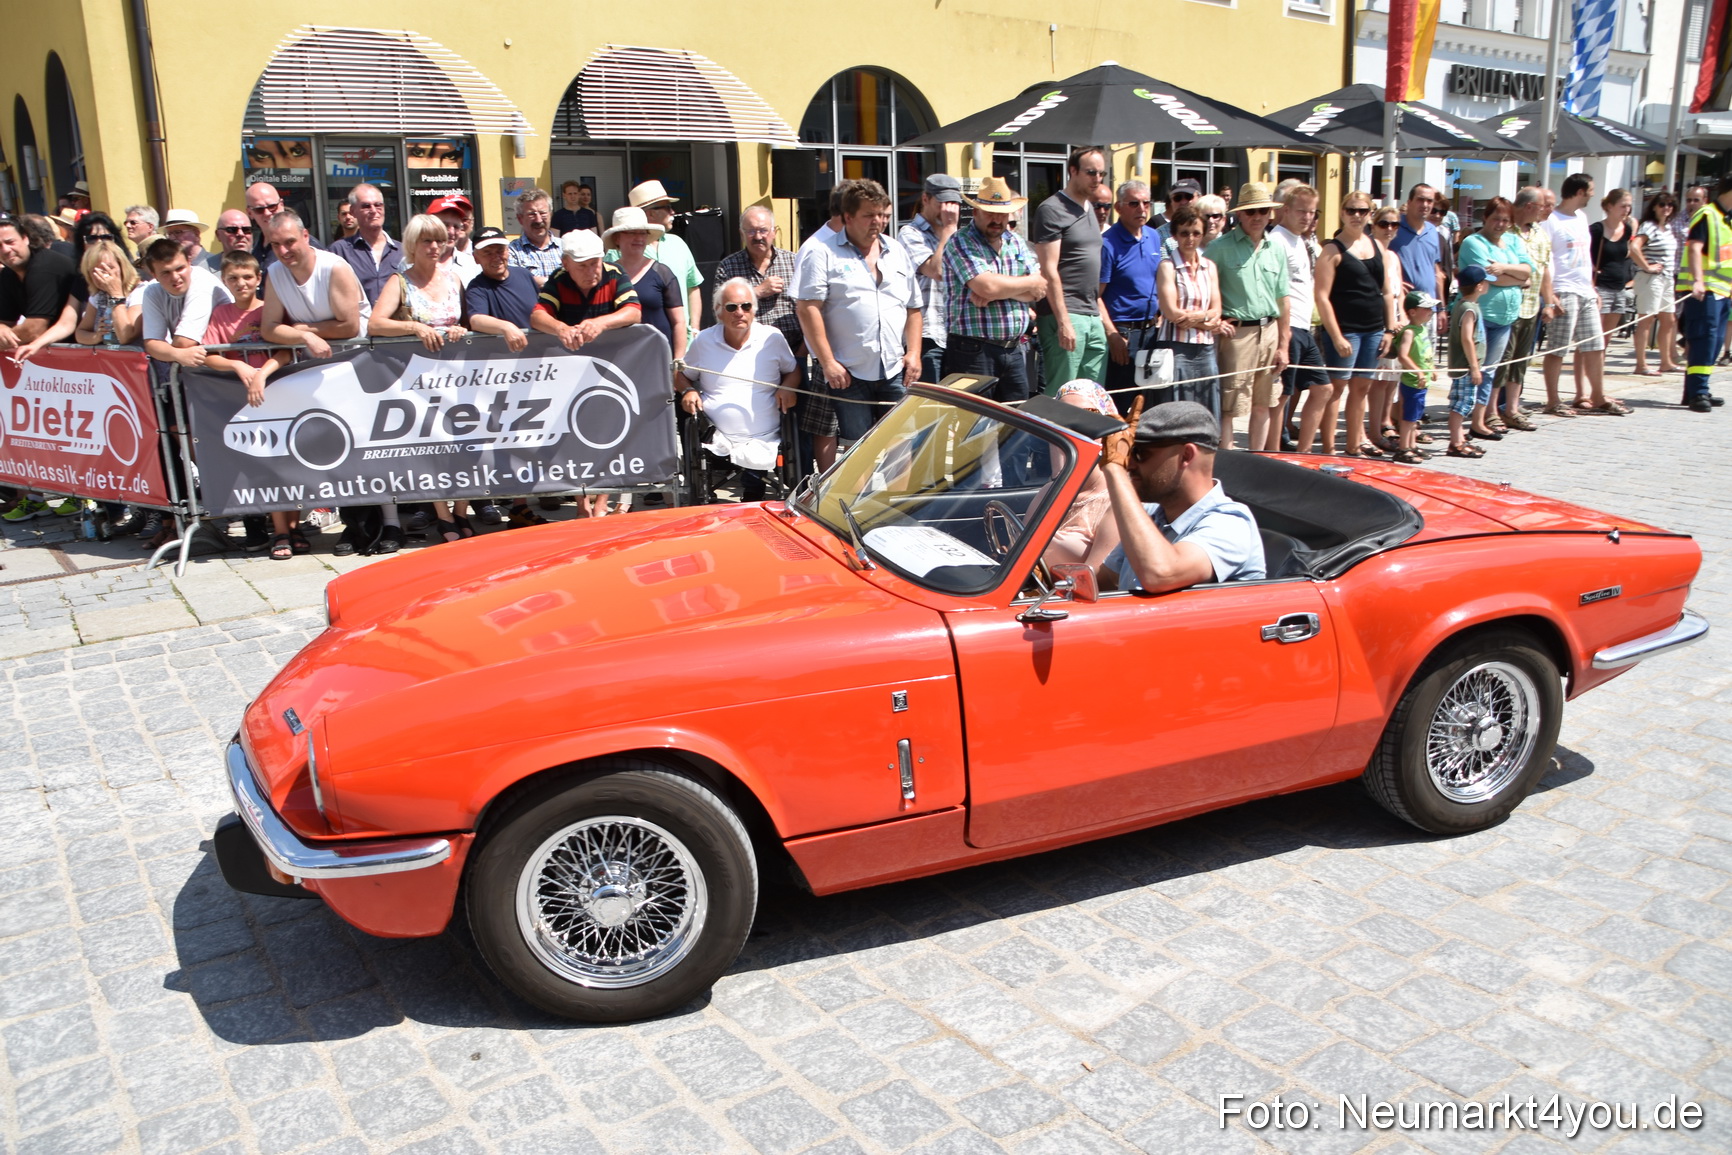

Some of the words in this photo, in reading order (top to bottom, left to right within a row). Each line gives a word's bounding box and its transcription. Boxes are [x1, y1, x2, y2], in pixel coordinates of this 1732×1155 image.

[250, 174, 280, 184] Digitale
[281, 174, 305, 183] Bilder
[421, 174, 459, 182] Passbilder
[1329, 168, 1338, 179] 24
[24, 376, 95, 395] Autoklassik
[408, 363, 558, 391] Autoklassik
[11, 395, 94, 440] Dietz
[368, 390, 553, 442] Dietz
[10, 438, 57, 451] BREITENBRUNN
[362, 443, 463, 461] BREITENBRUNN
[233, 453, 645, 505] www.autoklassik-dietz.de
